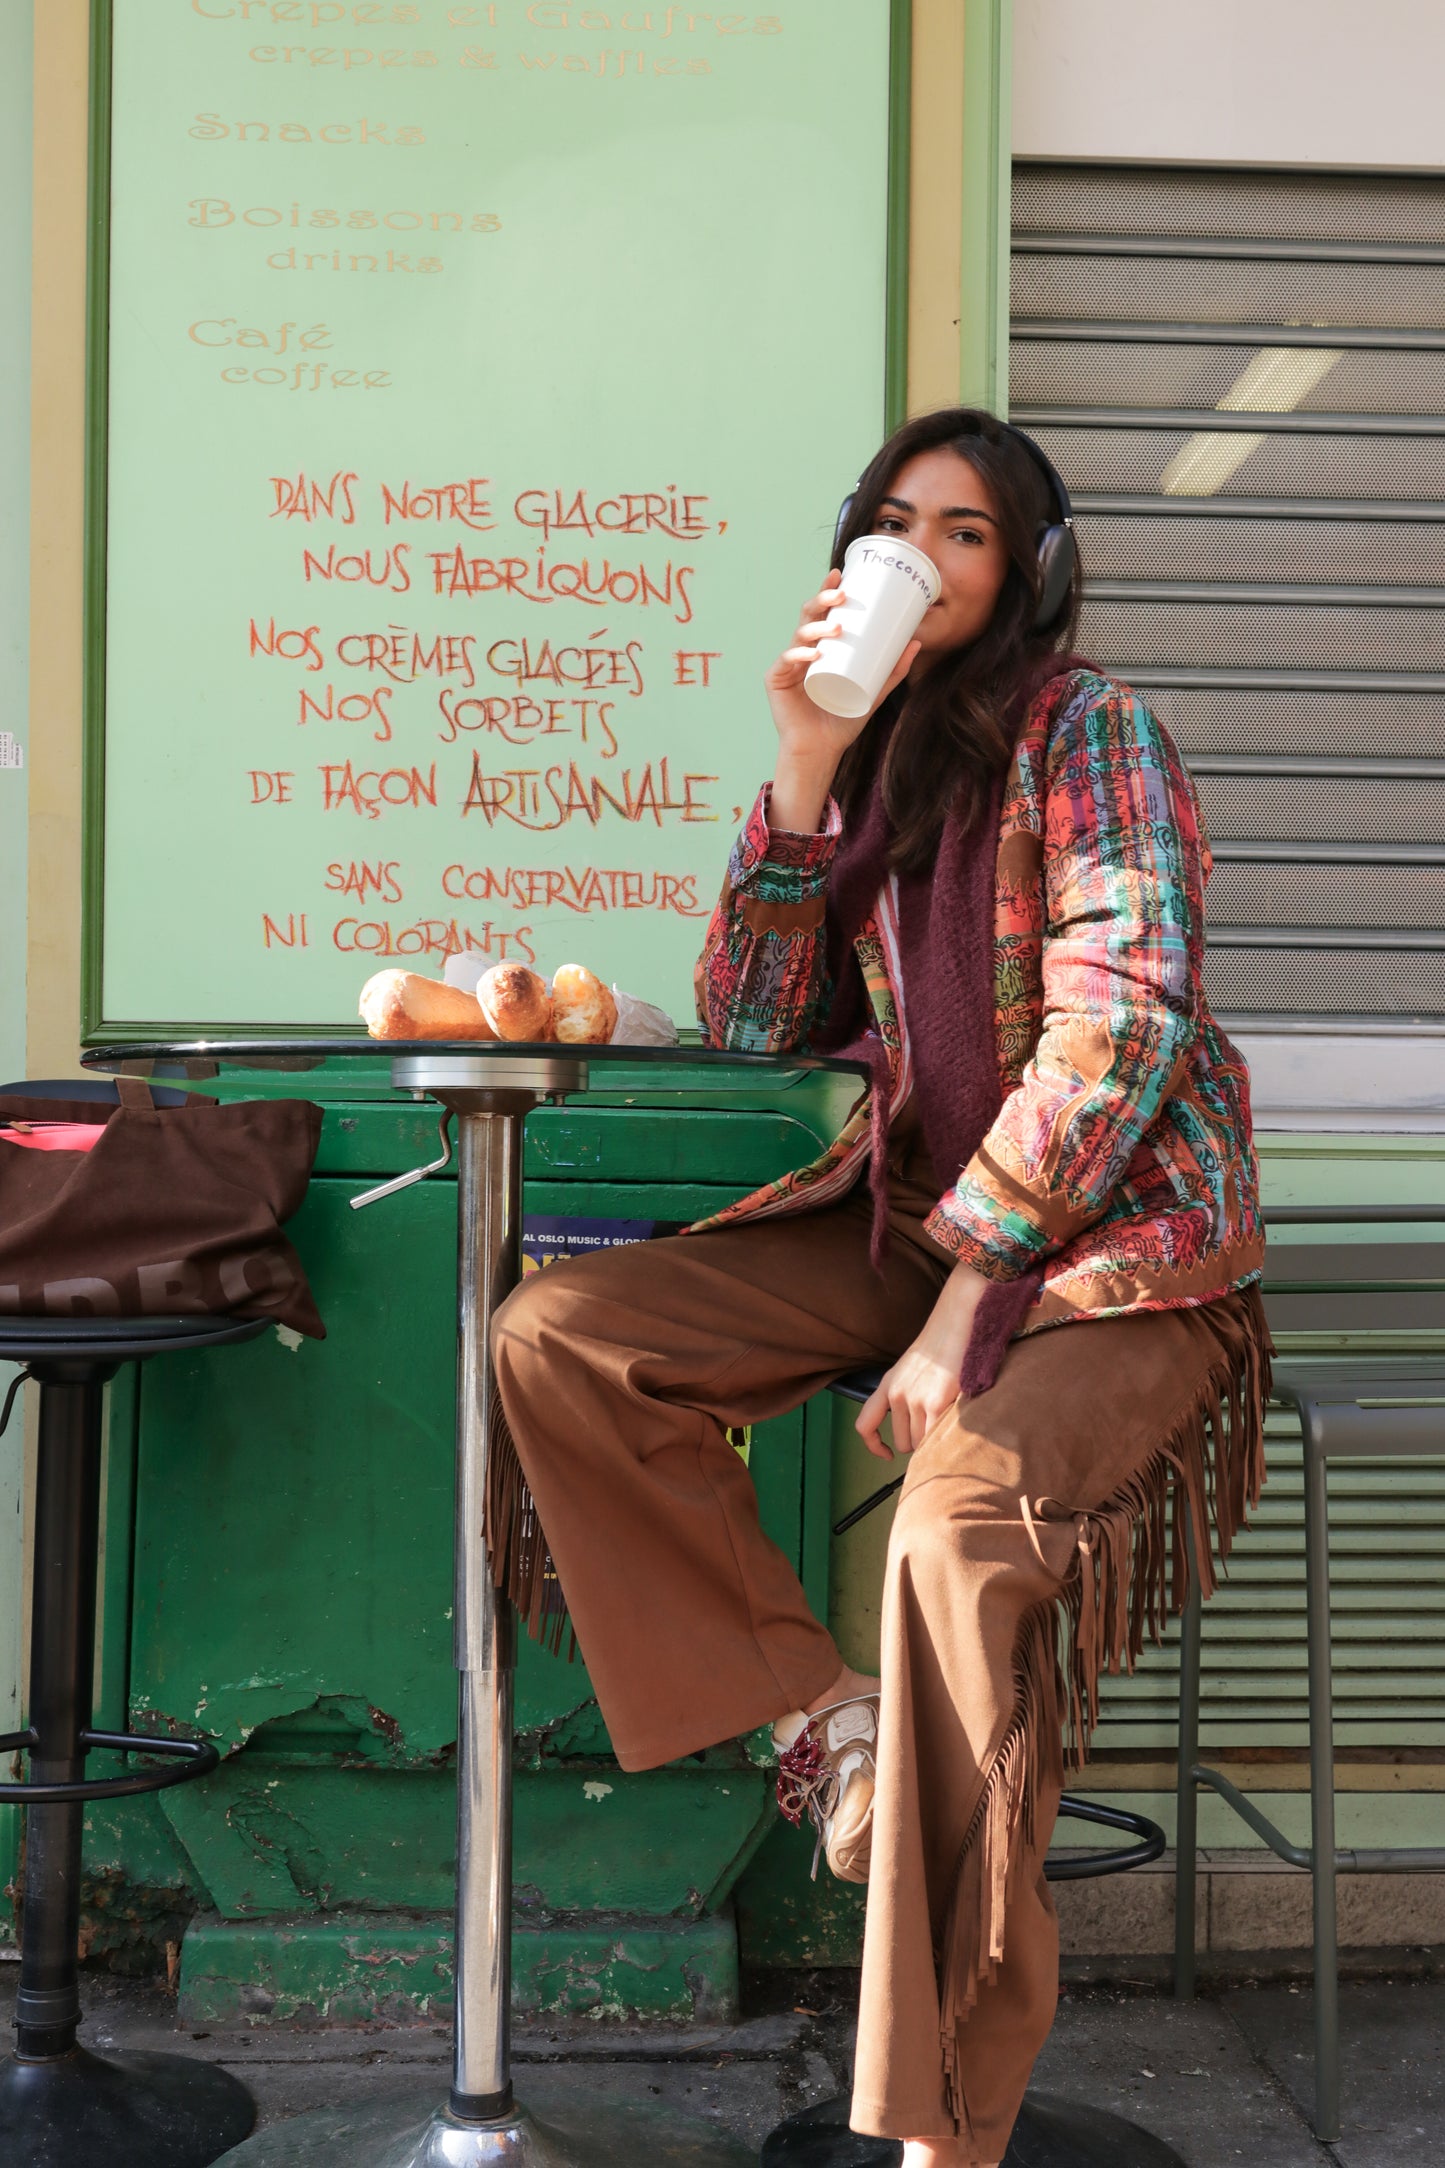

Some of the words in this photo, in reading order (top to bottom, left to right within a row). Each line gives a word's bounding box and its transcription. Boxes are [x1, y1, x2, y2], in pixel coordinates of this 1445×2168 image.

[446, 3, 499, 29] et
[526, 0, 785, 39] Gaufres
[248, 45, 439, 71] crepes
[459, 44, 501, 70] &
[518, 49, 713, 79] waffles
[187, 113, 428, 147] Snacks
[187, 199, 504, 233] Boissons
[266, 247, 445, 274] drinks
[187, 318, 335, 355] Café
[219, 362, 393, 391] coffee
[268, 471, 360, 526] DANS
[302, 543, 412, 593] NOUS
[248, 616, 324, 671] NOS
[337, 624, 477, 688] CRÈMES
[486, 627, 645, 698] GLACÉES
[672, 649, 724, 688] ET
[297, 683, 394, 743] NOS
[438, 689, 619, 759] SORBETS
[246, 769, 295, 804] DE
[317, 759, 438, 820] FAÇON
[324, 860, 404, 905] SANS
[440, 864, 711, 918] CONSERVATEURS
[261, 912, 310, 949] NI
[332, 916, 536, 968] COLORANTS
[537, 1234, 566, 1244] OSLO
[567, 1235, 601, 1245] MUSIC
[602, 1237, 610, 1246] &
